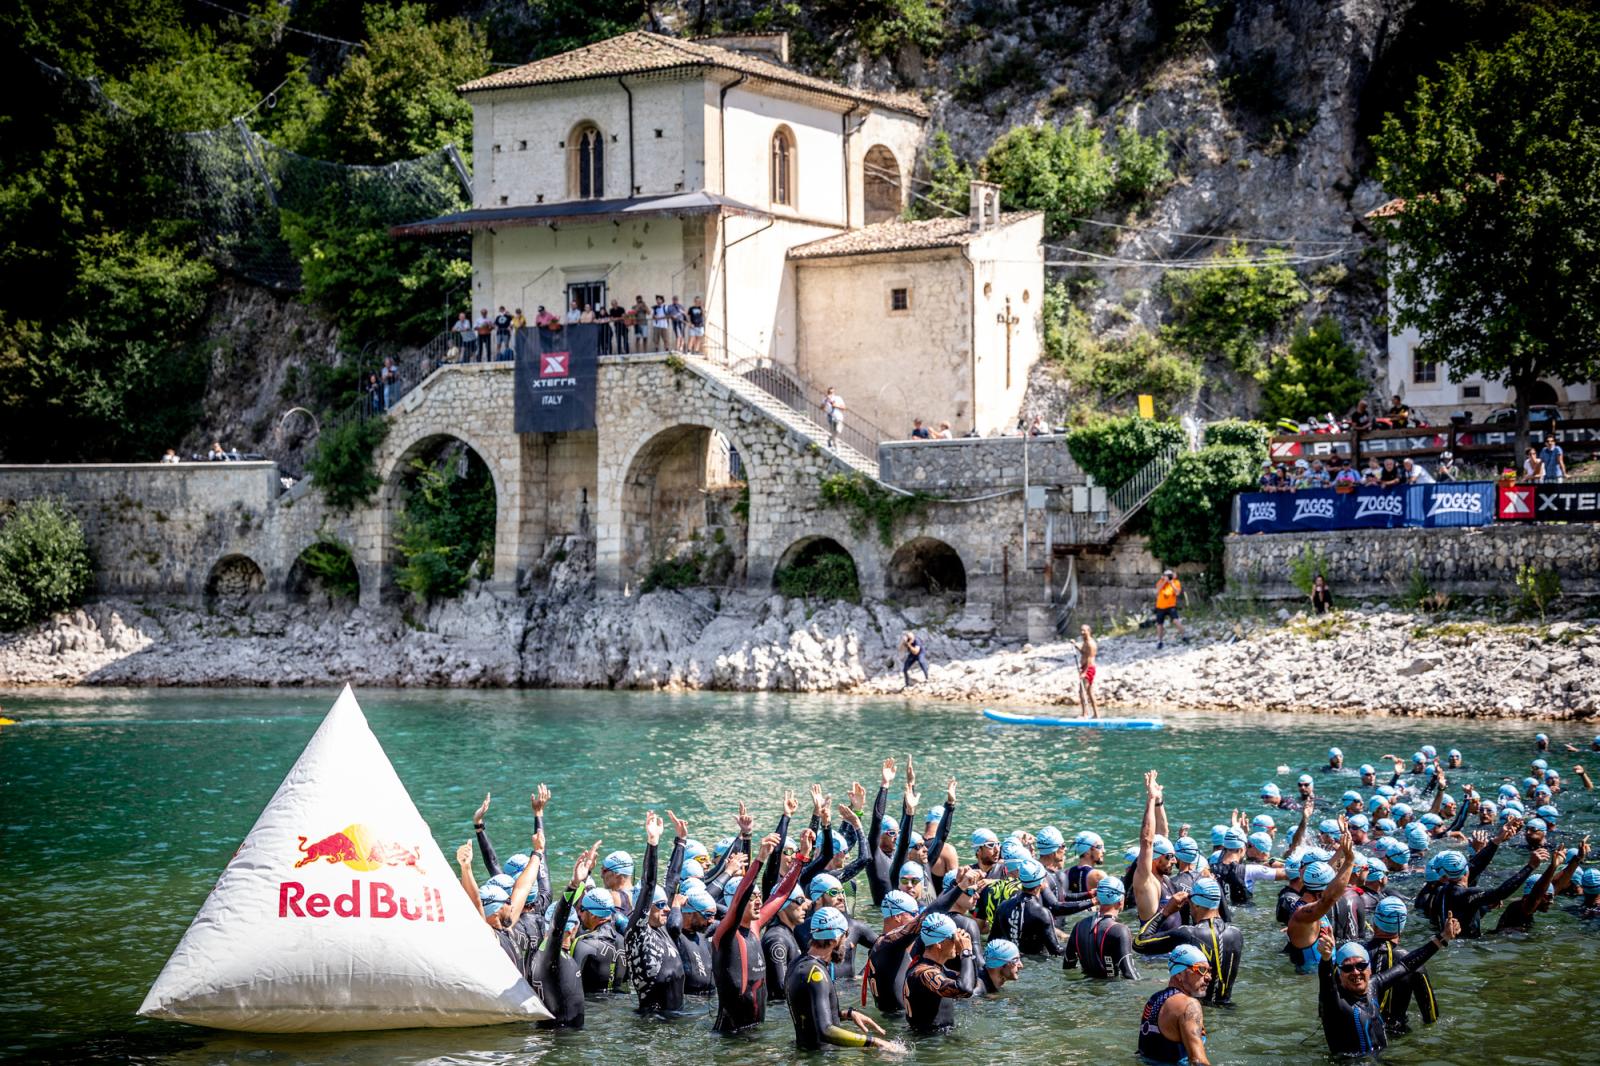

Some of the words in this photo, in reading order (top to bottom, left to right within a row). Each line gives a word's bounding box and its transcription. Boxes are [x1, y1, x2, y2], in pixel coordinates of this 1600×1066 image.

[532, 377, 577, 388] XTERRA
[541, 394, 563, 406] ITALY
[1247, 501, 1277, 525] ZOGGS
[1292, 498, 1335, 522] ZOGGS
[1354, 495, 1404, 519] ZOGGS
[1427, 492, 1483, 518] ZOGGS
[1538, 491, 1600, 511] XTE
[278, 879, 361, 918] Red
[369, 881, 445, 923] Bull
